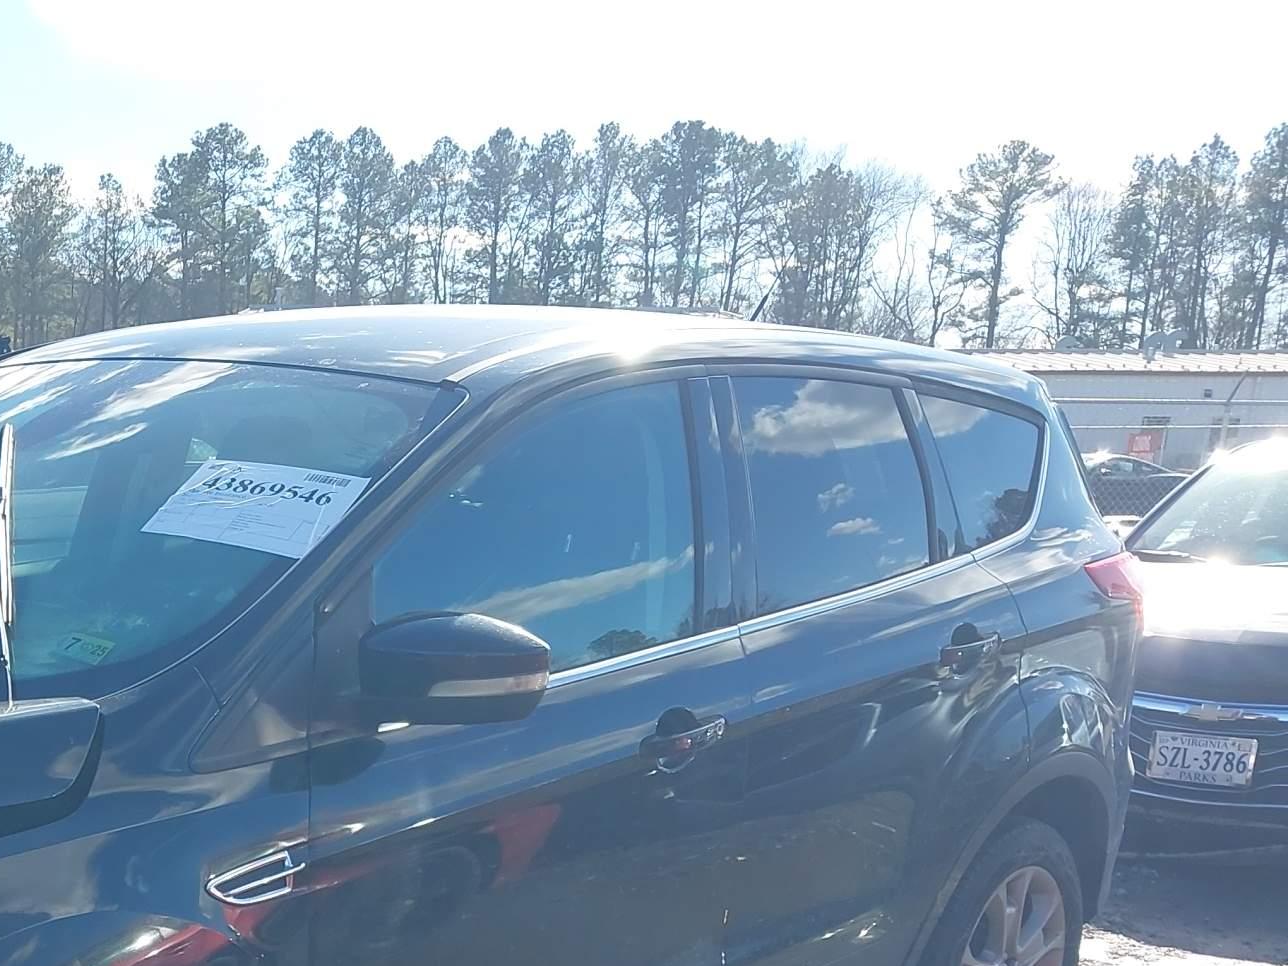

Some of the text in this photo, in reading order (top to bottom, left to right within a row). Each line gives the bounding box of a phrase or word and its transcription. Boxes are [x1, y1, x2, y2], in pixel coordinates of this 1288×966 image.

[202, 476, 336, 506] 43869546
[64, 637, 82, 650] 7
[1179, 737, 1230, 749] VIRGINIA
[1157, 745, 1250, 774] SZL-3786
[1179, 771, 1217, 783] PARKS
